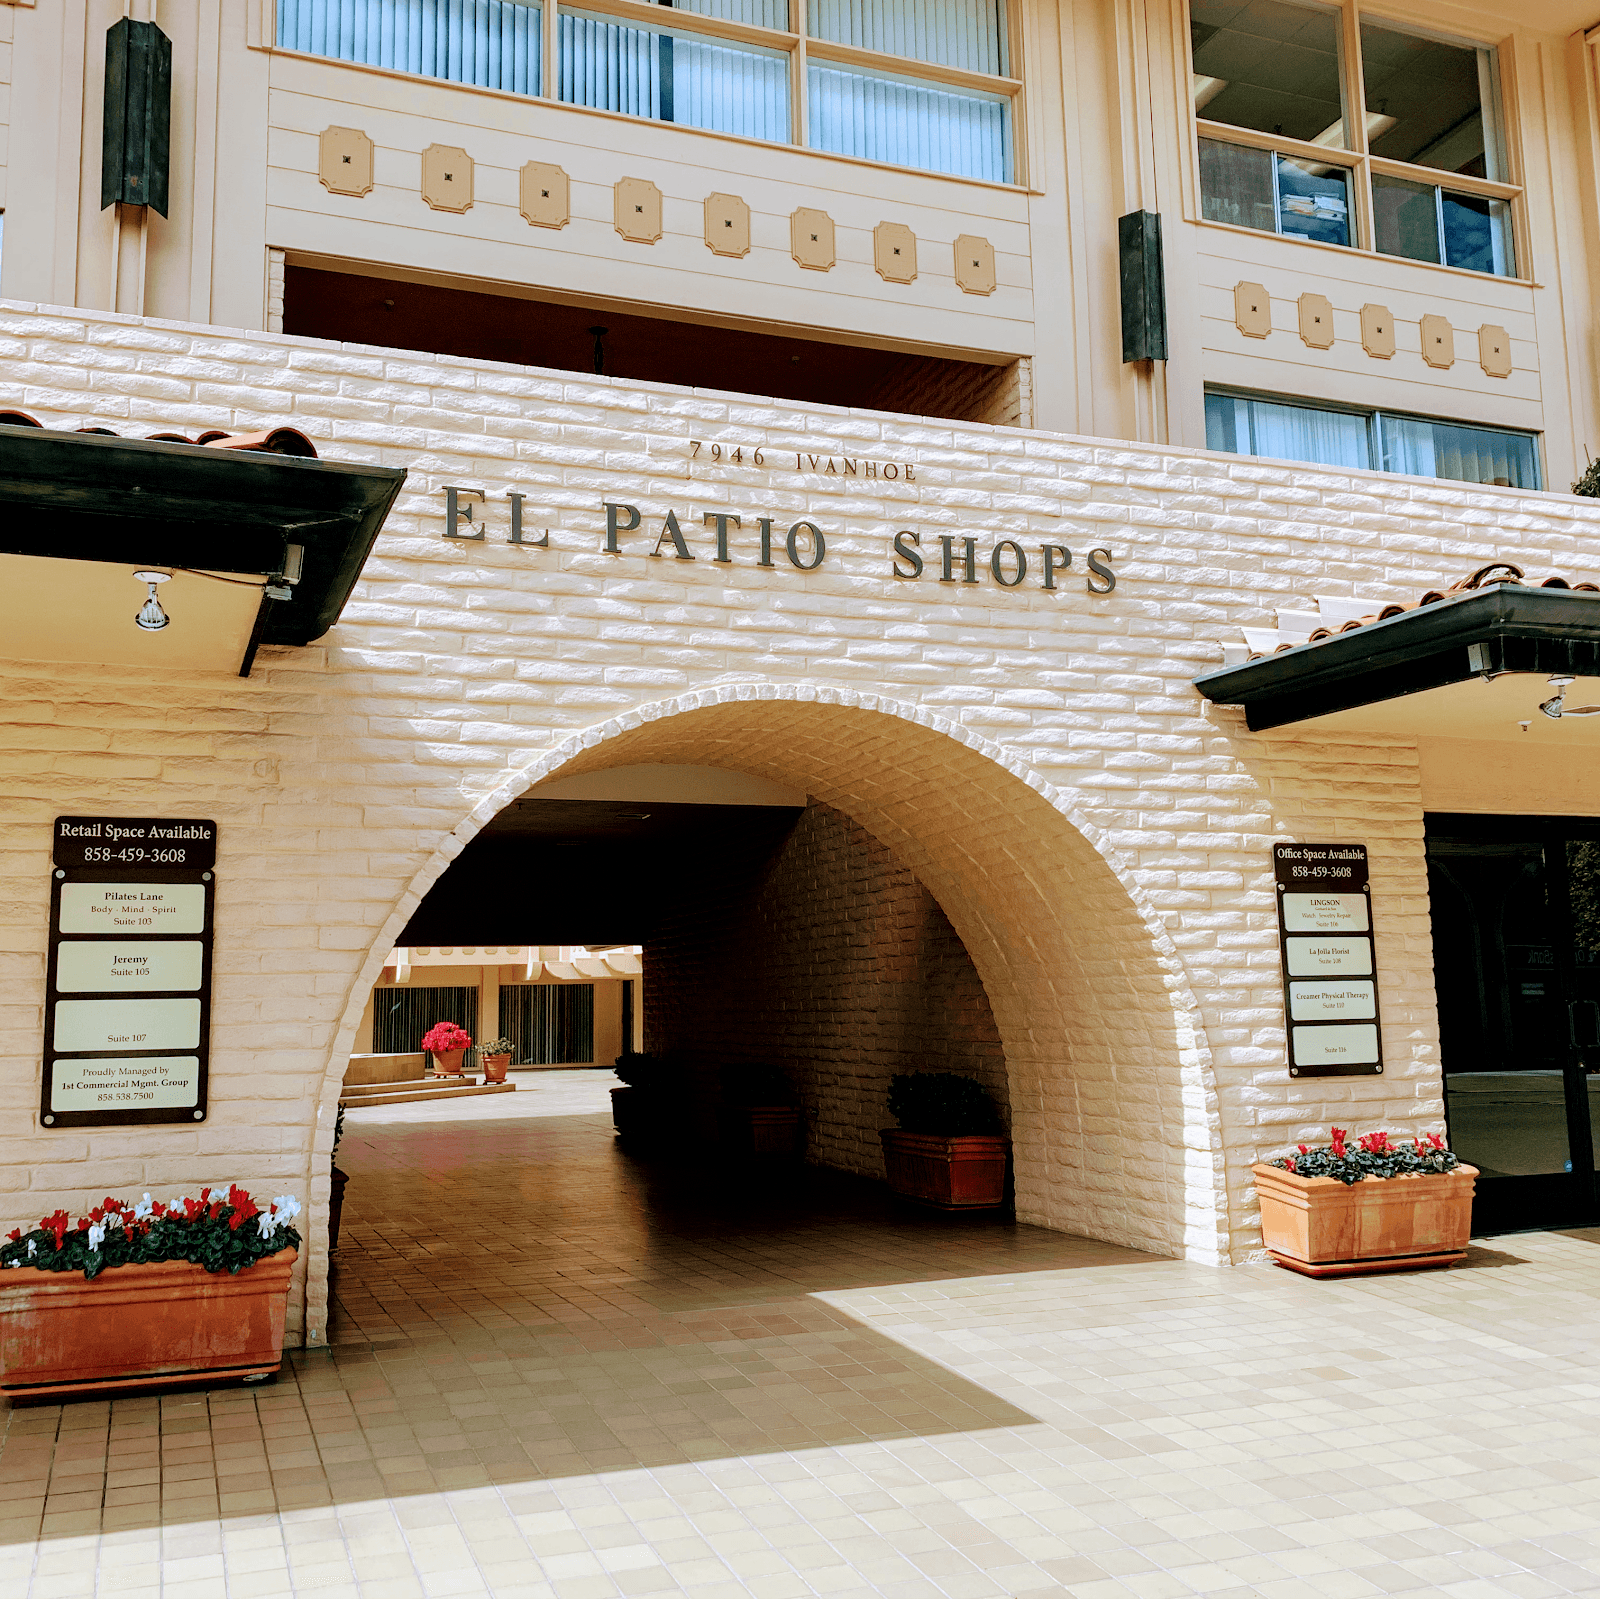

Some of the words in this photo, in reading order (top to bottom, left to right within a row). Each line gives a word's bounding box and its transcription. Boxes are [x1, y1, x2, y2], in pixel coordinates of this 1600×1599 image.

[689, 440, 765, 466] 7946
[795, 452, 917, 482] IVANHOE
[441, 484, 550, 548] EL
[602, 501, 827, 571] PATIO
[892, 530, 1116, 596] SHOPS
[60, 823, 102, 837] Retail
[105, 824, 145, 841] Space
[148, 825, 211, 839] Available
[84, 847, 186, 863] 858-459-3608
[1277, 848, 1302, 859] Office
[1303, 848, 1327, 862] Space
[1327, 849, 1365, 860] Available
[1292, 866, 1352, 878] 858-459-3608
[104, 892, 138, 901] Pilates
[140, 892, 164, 901] Lane
[91, 905, 113, 915] Body
[121, 905, 144, 913] Mind
[152, 906, 176, 915] Spirit
[113, 918, 136, 926] Suite
[138, 918, 152, 926] 103
[112, 955, 148, 966] Jeremy
[110, 968, 133, 976] Suite
[135, 968, 150, 976] 105
[1321, 992, 1345, 1000] Physical
[1346, 992, 1369, 1000] Therapy
[107, 1034, 130, 1043] Suite
[132, 1034, 147, 1042] 107
[82, 1068, 116, 1077] Proudly
[118, 1067, 157, 1077] Managed
[159, 1066, 170, 1075] by
[62, 1082, 74, 1090] 1st
[76, 1080, 129, 1090] Commercial
[131, 1080, 159, 1090] Mgmt.
[161, 1079, 189, 1088] Group
[97, 1092, 154, 1102] 858.538.7500
